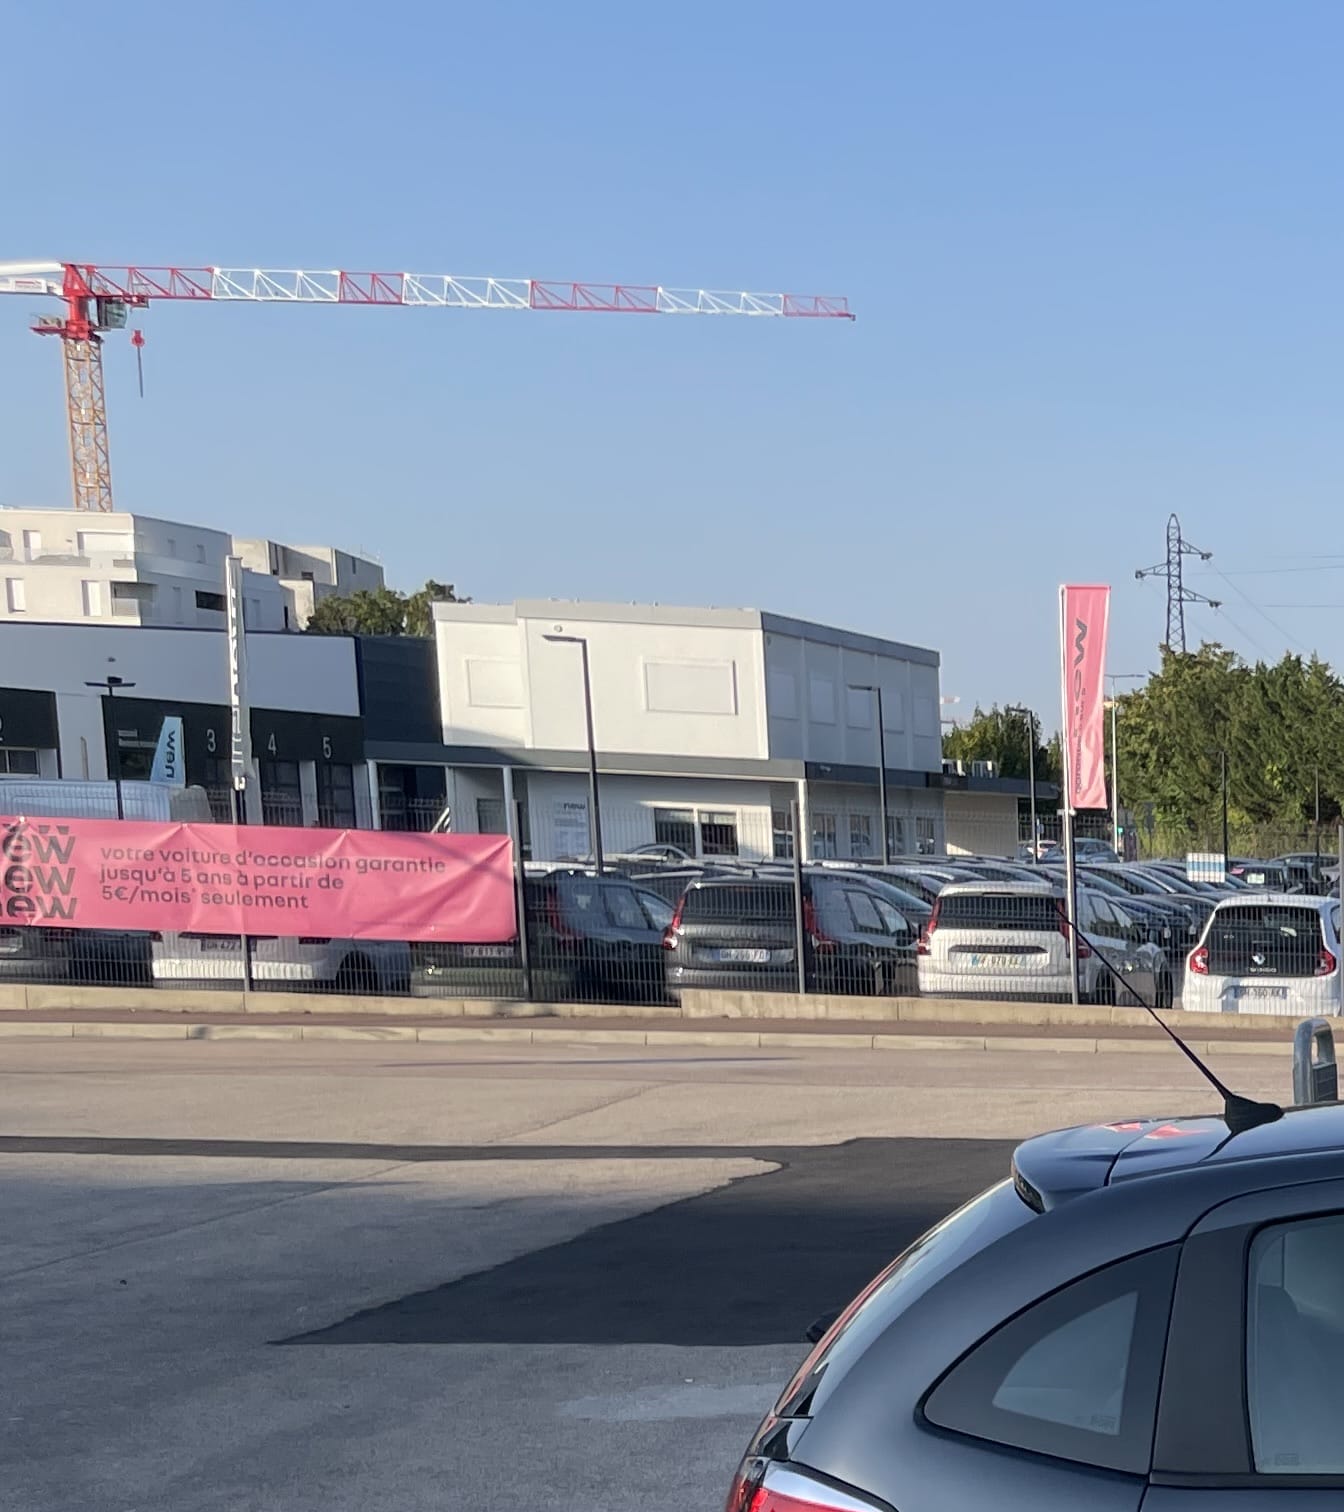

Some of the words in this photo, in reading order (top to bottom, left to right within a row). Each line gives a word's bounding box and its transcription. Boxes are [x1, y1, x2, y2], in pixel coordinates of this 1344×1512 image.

[206, 729, 216, 752] 3
[268, 732, 277, 755] 4
[322, 736, 332, 759] 5
[101, 848, 154, 862] votre
[160, 848, 231, 864] voiture
[235, 851, 350, 869] d'occasion
[355, 857, 446, 874] garantie
[99, 865, 175, 885] jusqu'à
[181, 869, 192, 883] 5
[197, 873, 232, 885] ans
[237, 871, 249, 886] à
[254, 874, 313, 889] partir
[318, 874, 344, 889] de
[201, 892, 309, 909] seulement
